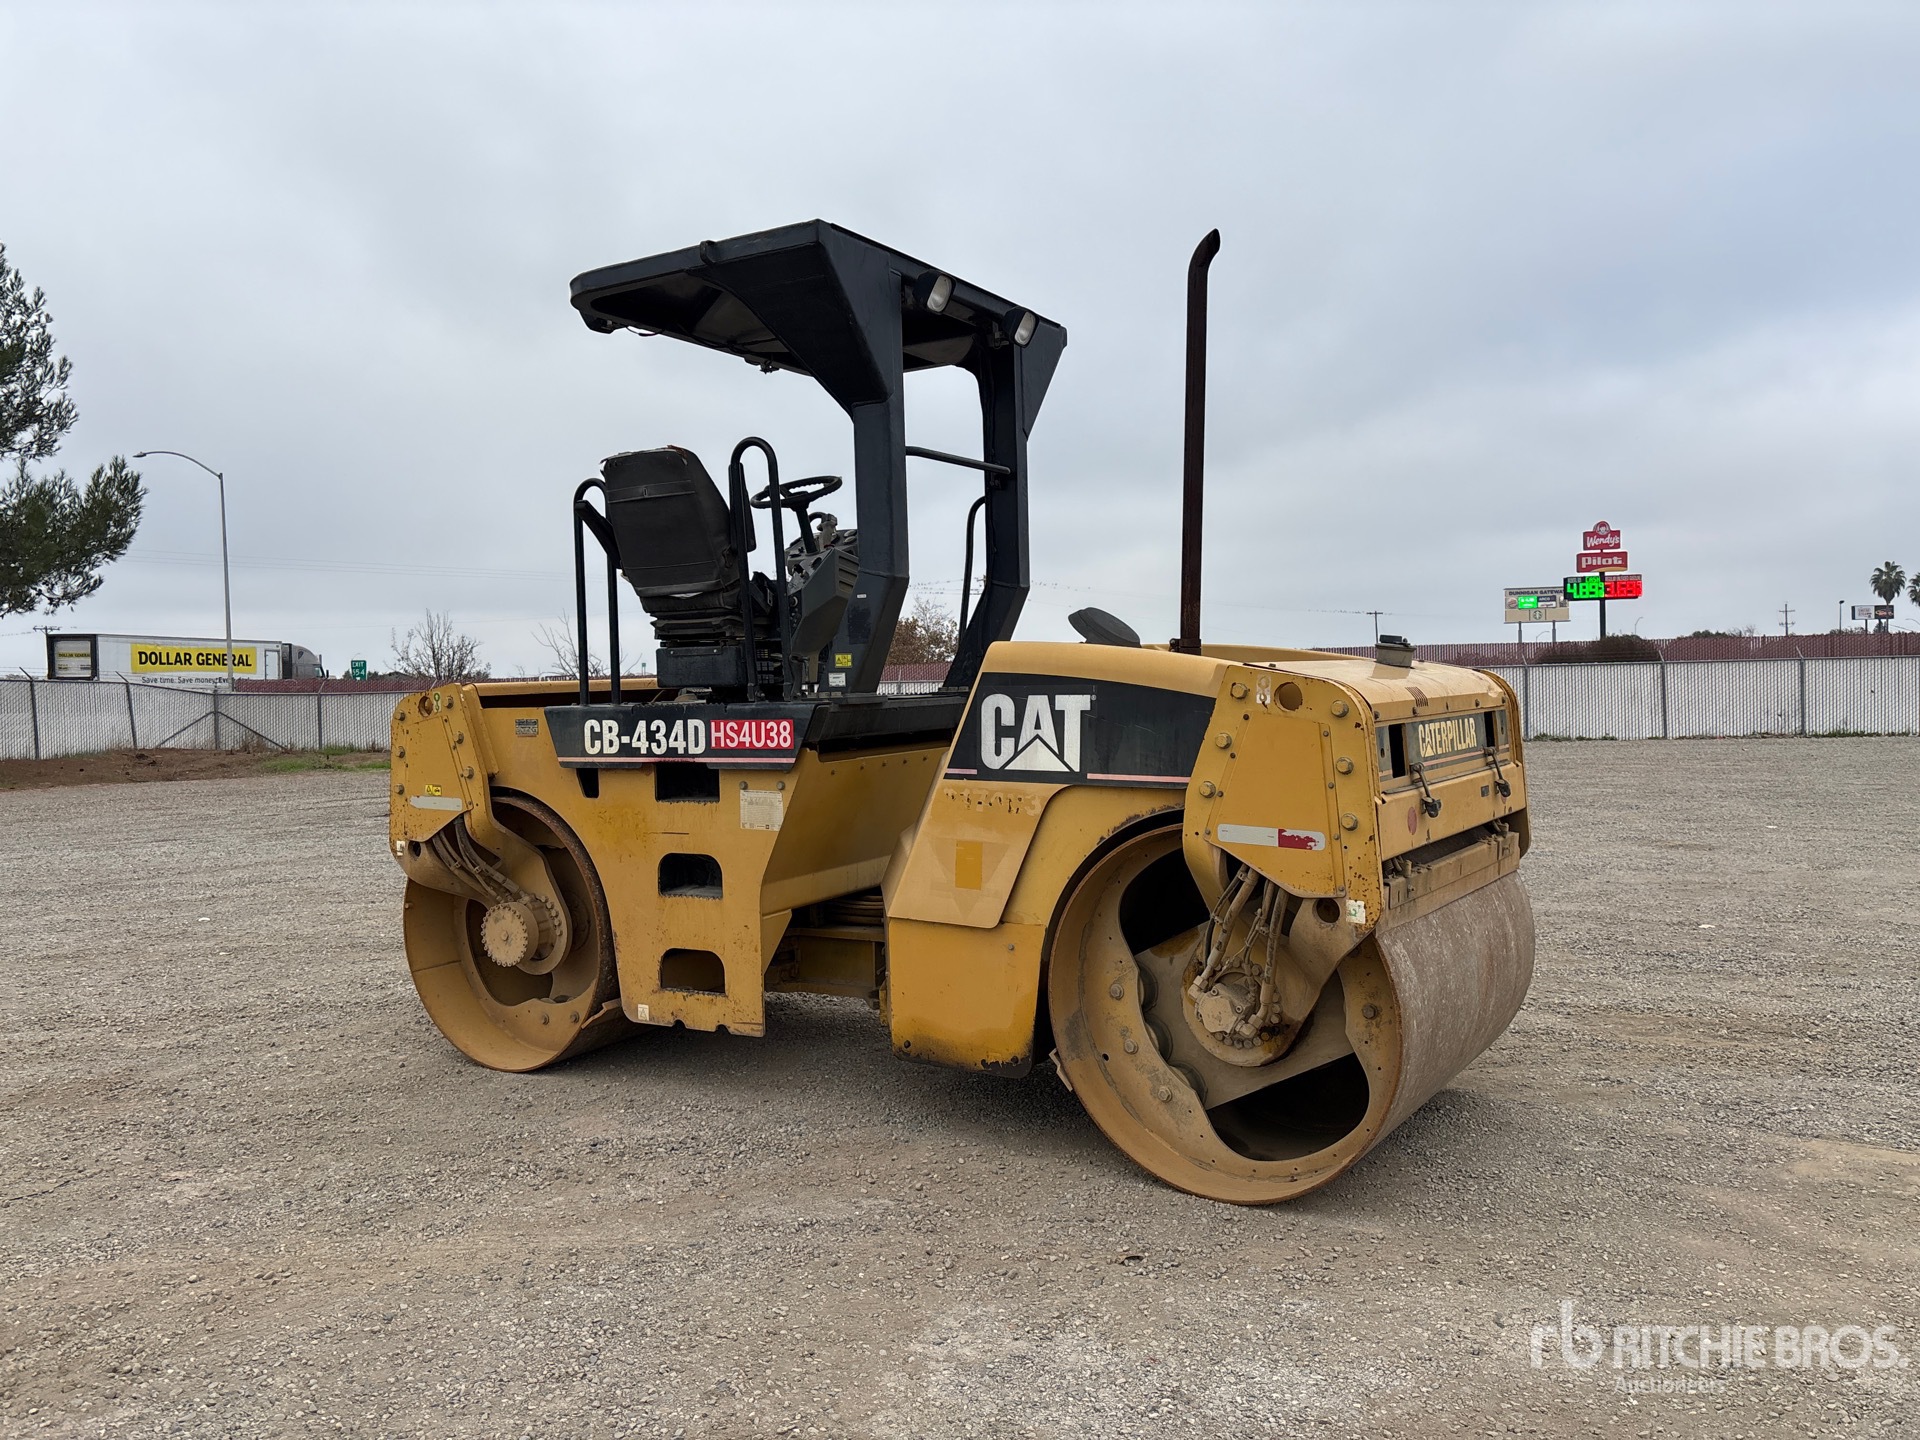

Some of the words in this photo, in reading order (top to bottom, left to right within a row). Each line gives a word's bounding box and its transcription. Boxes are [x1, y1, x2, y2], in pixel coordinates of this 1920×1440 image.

[1586, 534, 1620, 548] Wendy's
[1581, 556, 1623, 569] Pilot
[137, 651, 193, 666] DOLLAR
[141, 676, 158, 684] Save
[177, 676, 193, 684] Save
[584, 719, 706, 755] CB-434D
[711, 721, 791, 748] HS4U38
[981, 693, 1091, 772] CAT
[1418, 717, 1477, 758] CATERPILLAR
